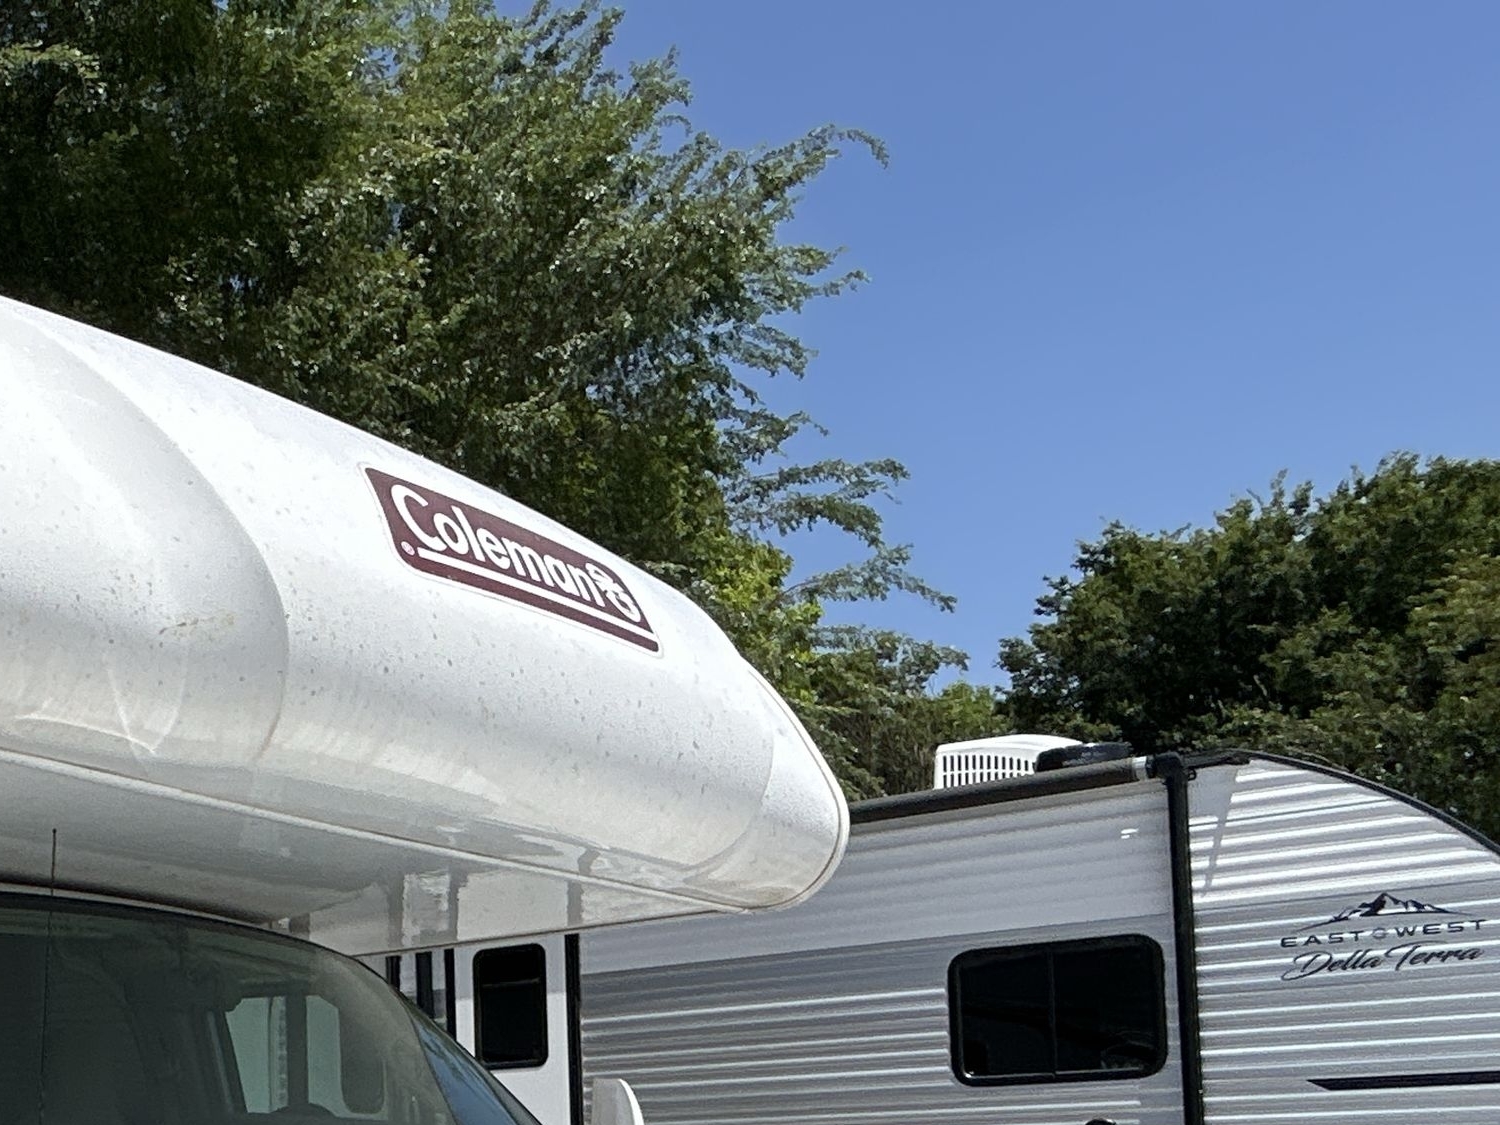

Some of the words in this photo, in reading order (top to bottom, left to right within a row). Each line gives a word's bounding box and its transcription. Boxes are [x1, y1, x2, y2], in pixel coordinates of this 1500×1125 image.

[391, 484, 604, 607] Coleman
[1280, 930, 1364, 948] EAST
[1395, 919, 1486, 938] WEST
[1280, 949, 1383, 981] Della
[1384, 940, 1485, 972] Terra
